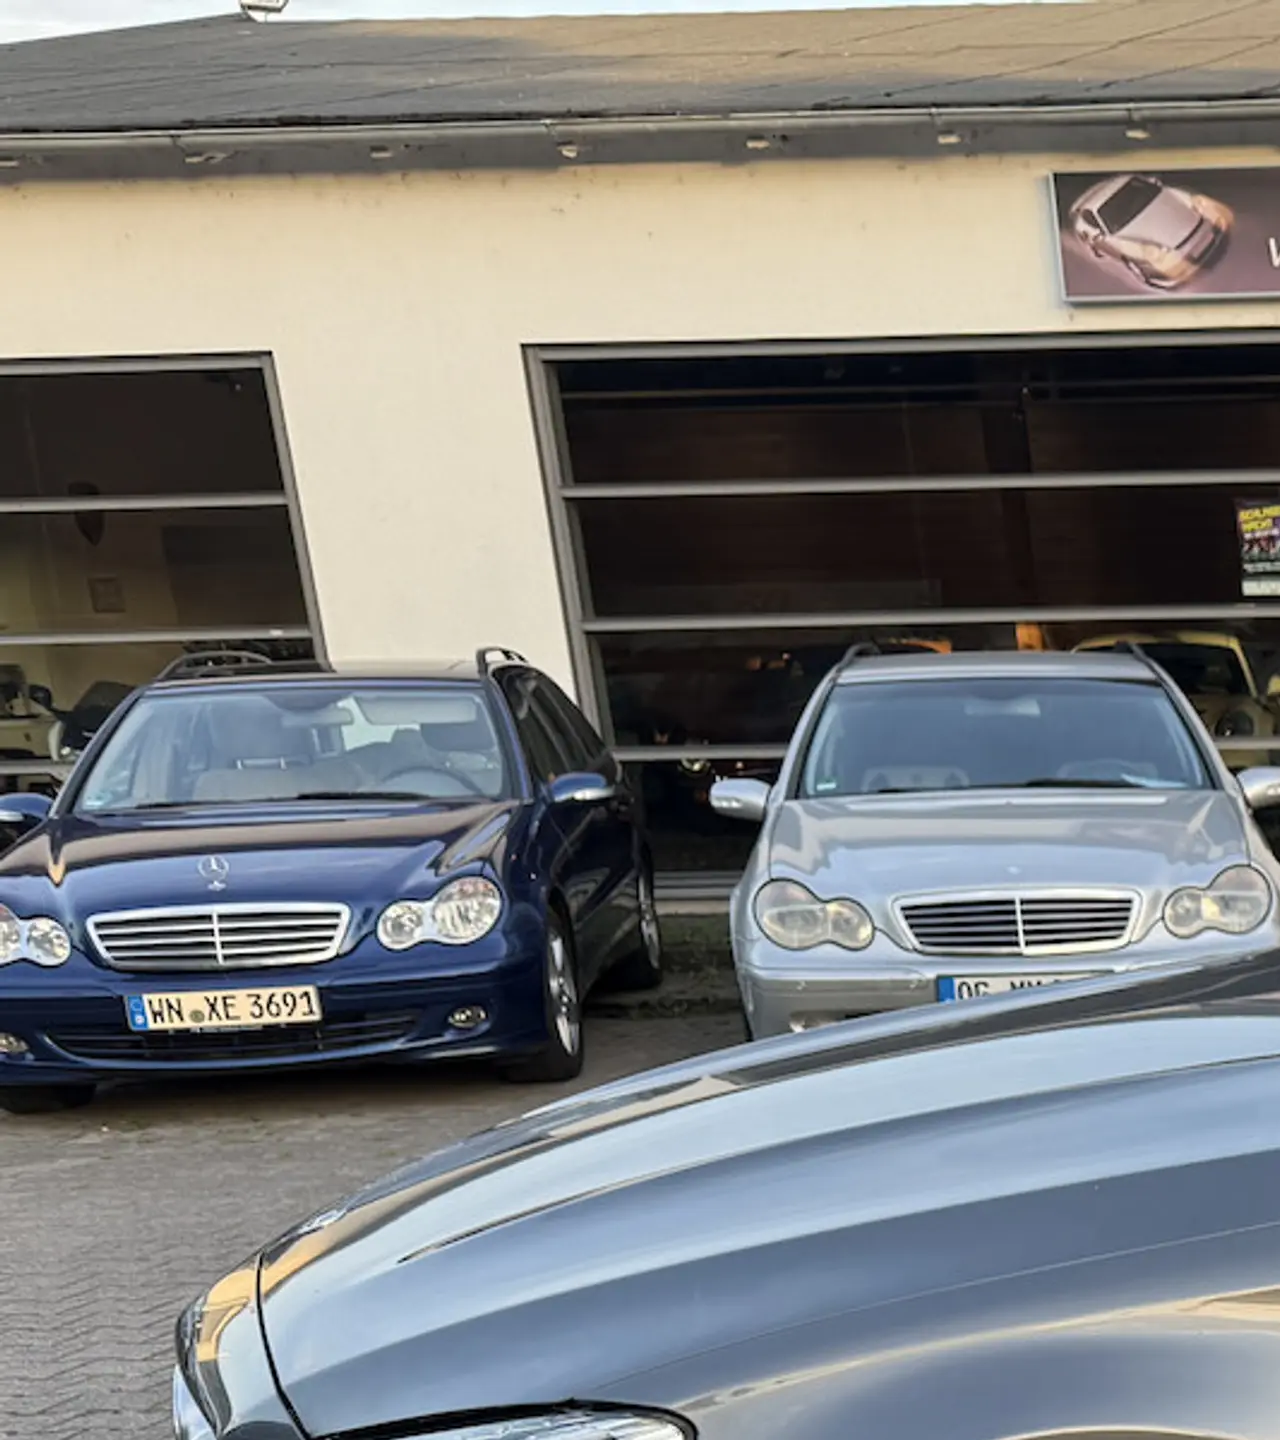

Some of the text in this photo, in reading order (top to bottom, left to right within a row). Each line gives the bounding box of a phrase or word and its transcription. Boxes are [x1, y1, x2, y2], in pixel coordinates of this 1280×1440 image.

[147, 990, 316, 1024] WN XE 3691
